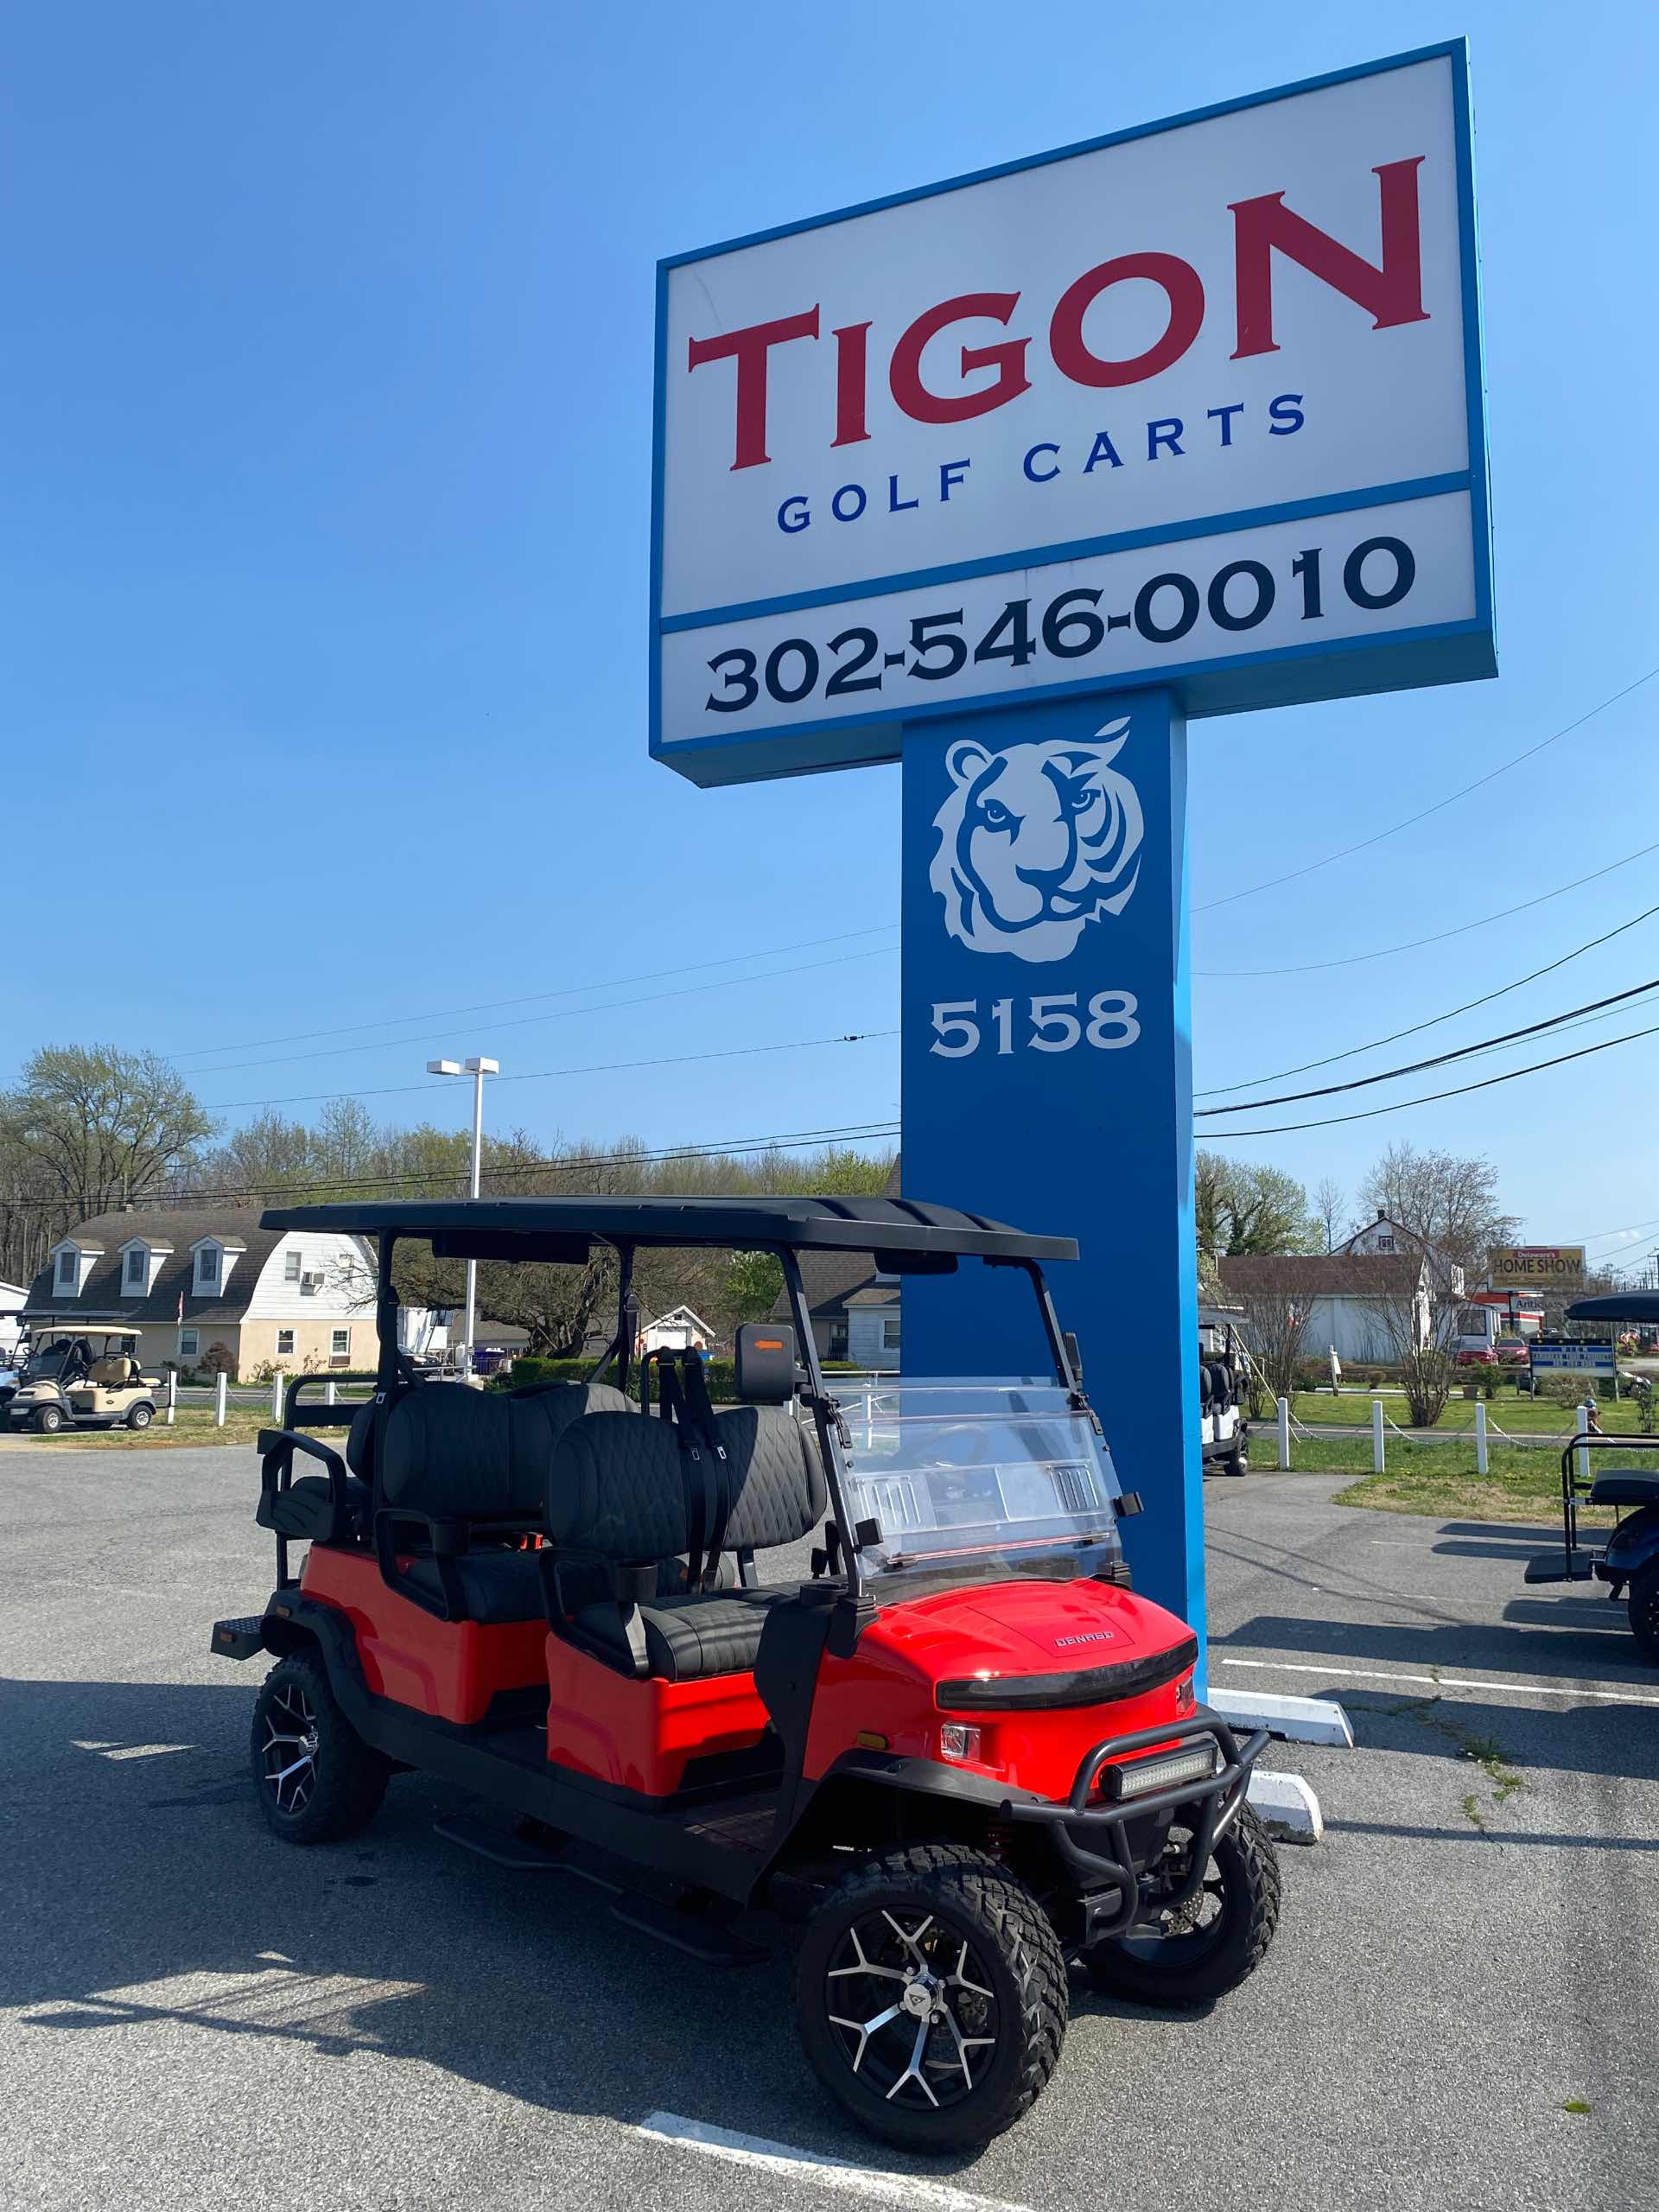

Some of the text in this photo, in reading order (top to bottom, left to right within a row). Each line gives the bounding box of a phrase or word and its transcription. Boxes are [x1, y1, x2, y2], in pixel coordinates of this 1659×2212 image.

[688, 155, 1432, 473] TIGON
[777, 393, 1306, 535] GOLF CARTS
[704, 536, 1416, 714] 302-546-0010
[929, 989, 1141, 1058] 5158
[1493, 1258, 1581, 1273] HOME SHOW
